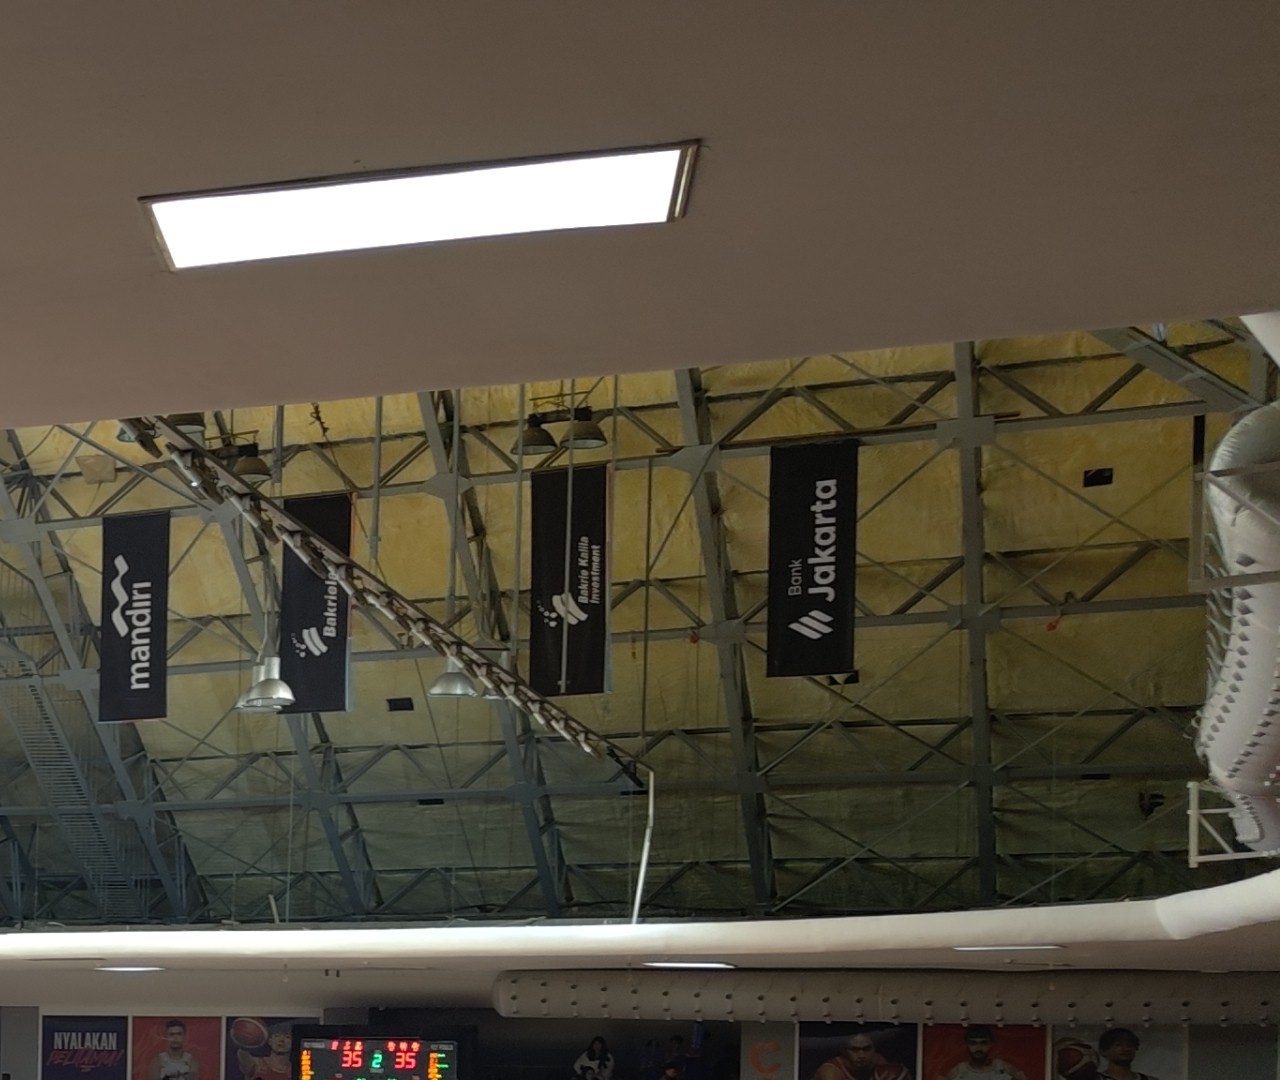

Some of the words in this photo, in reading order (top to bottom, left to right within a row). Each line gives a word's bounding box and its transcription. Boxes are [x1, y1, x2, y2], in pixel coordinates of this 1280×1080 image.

[807, 478, 838, 603] Jakarta
[788, 558, 802, 597] Bank
[125, 581, 152, 690] mandiri
[53, 1031, 118, 1050] NYALAKAN
[341, 1051, 363, 1068] 35
[372, 1053, 383, 1068] 2
[394, 1052, 416, 1069] 35
